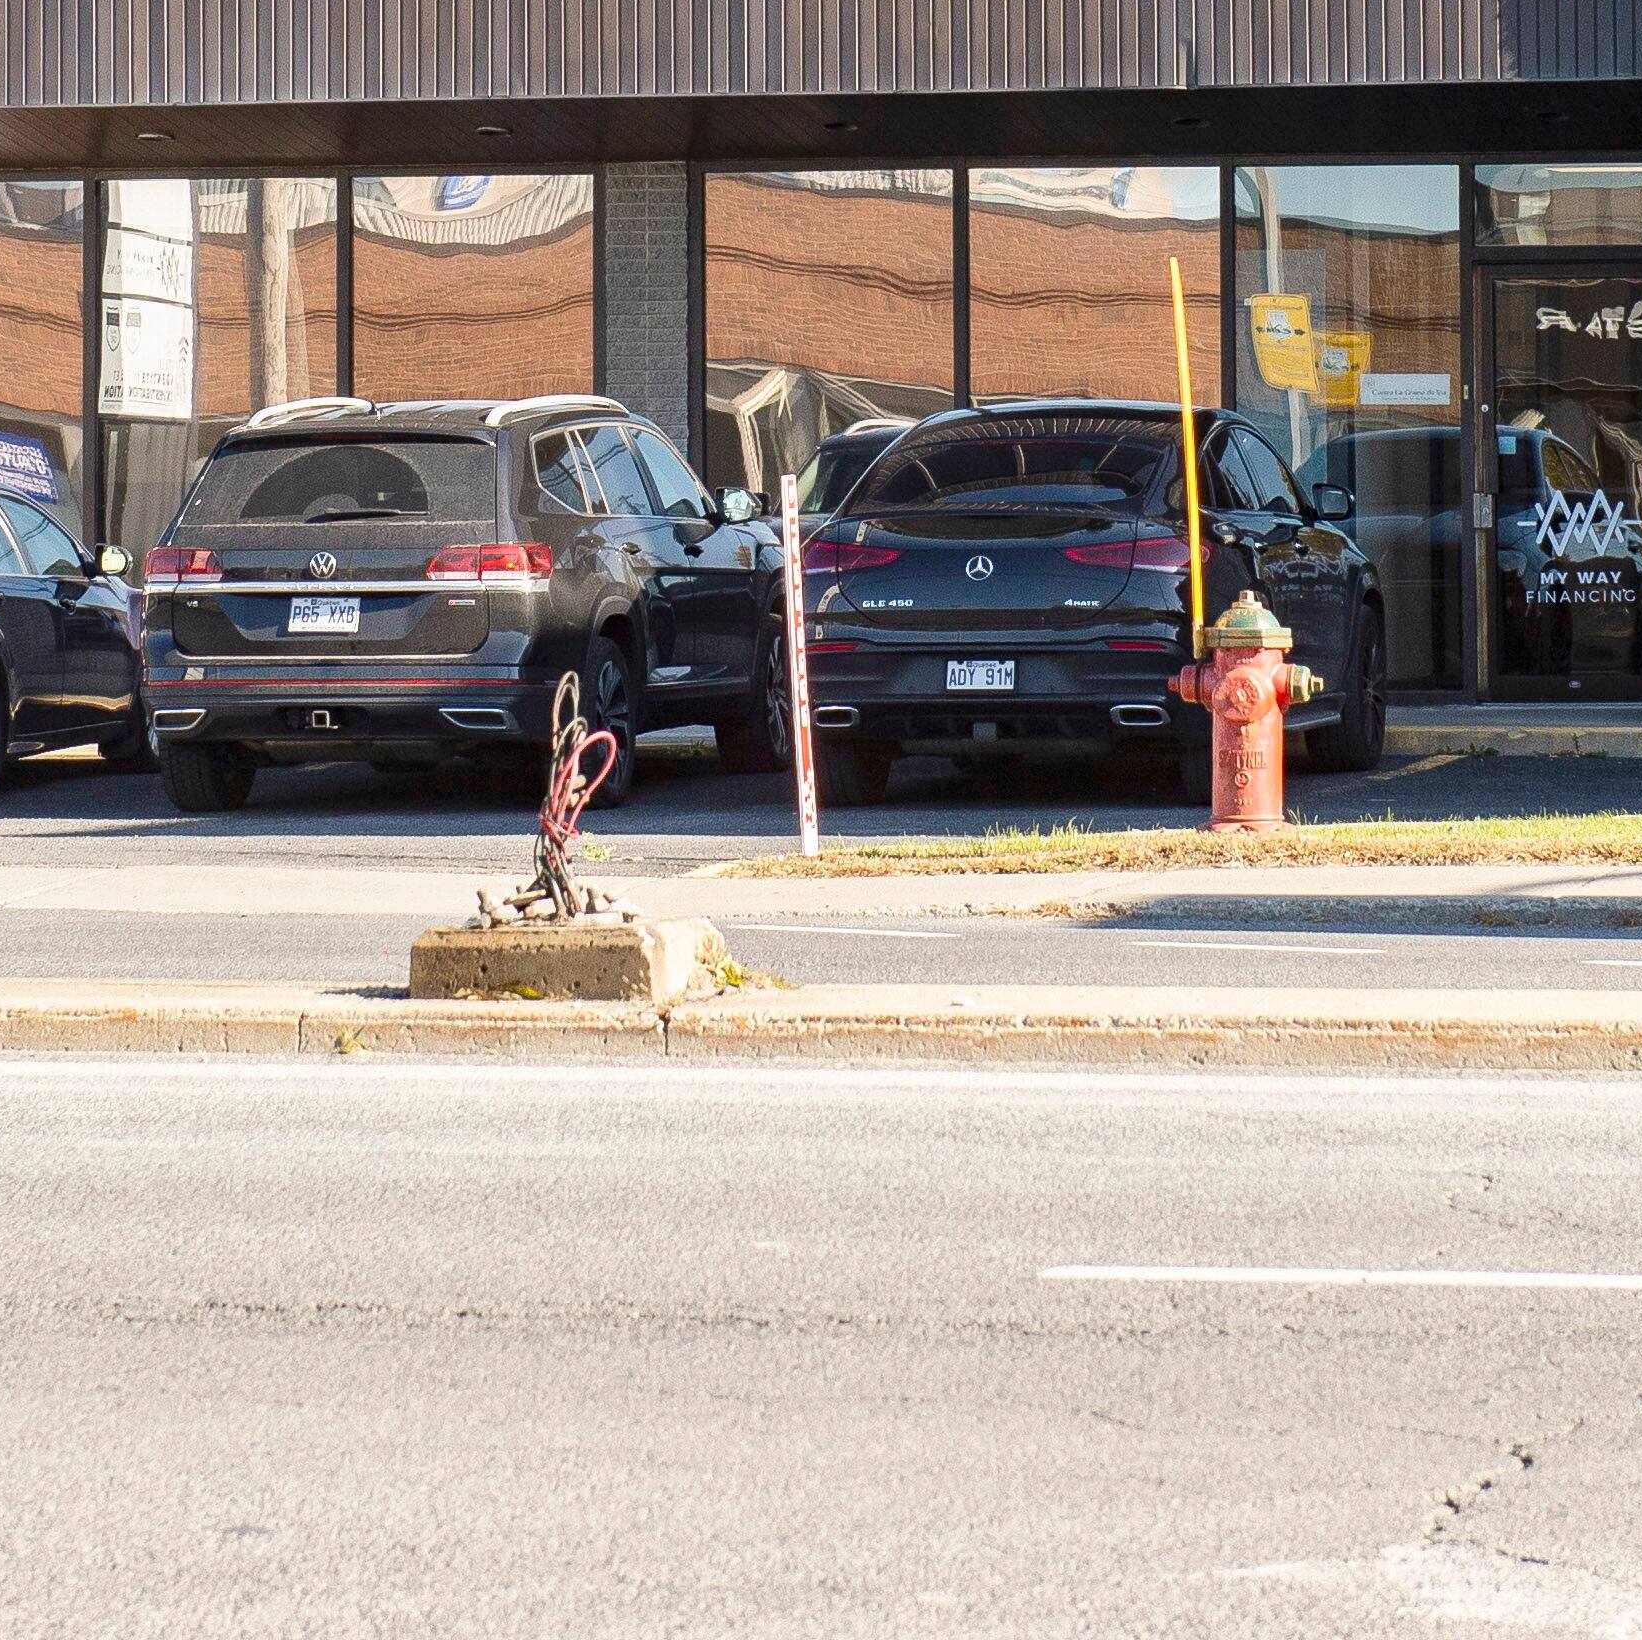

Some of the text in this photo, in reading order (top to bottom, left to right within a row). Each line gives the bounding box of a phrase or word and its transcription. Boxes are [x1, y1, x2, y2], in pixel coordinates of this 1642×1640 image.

[1540, 571, 1621, 584] MY WAY
[1526, 590, 1636, 603] FINANCING
[862, 599, 886, 608] GLE
[292, 605, 356, 623] P65 XXB
[948, 667, 1013, 687] ADY 91M
